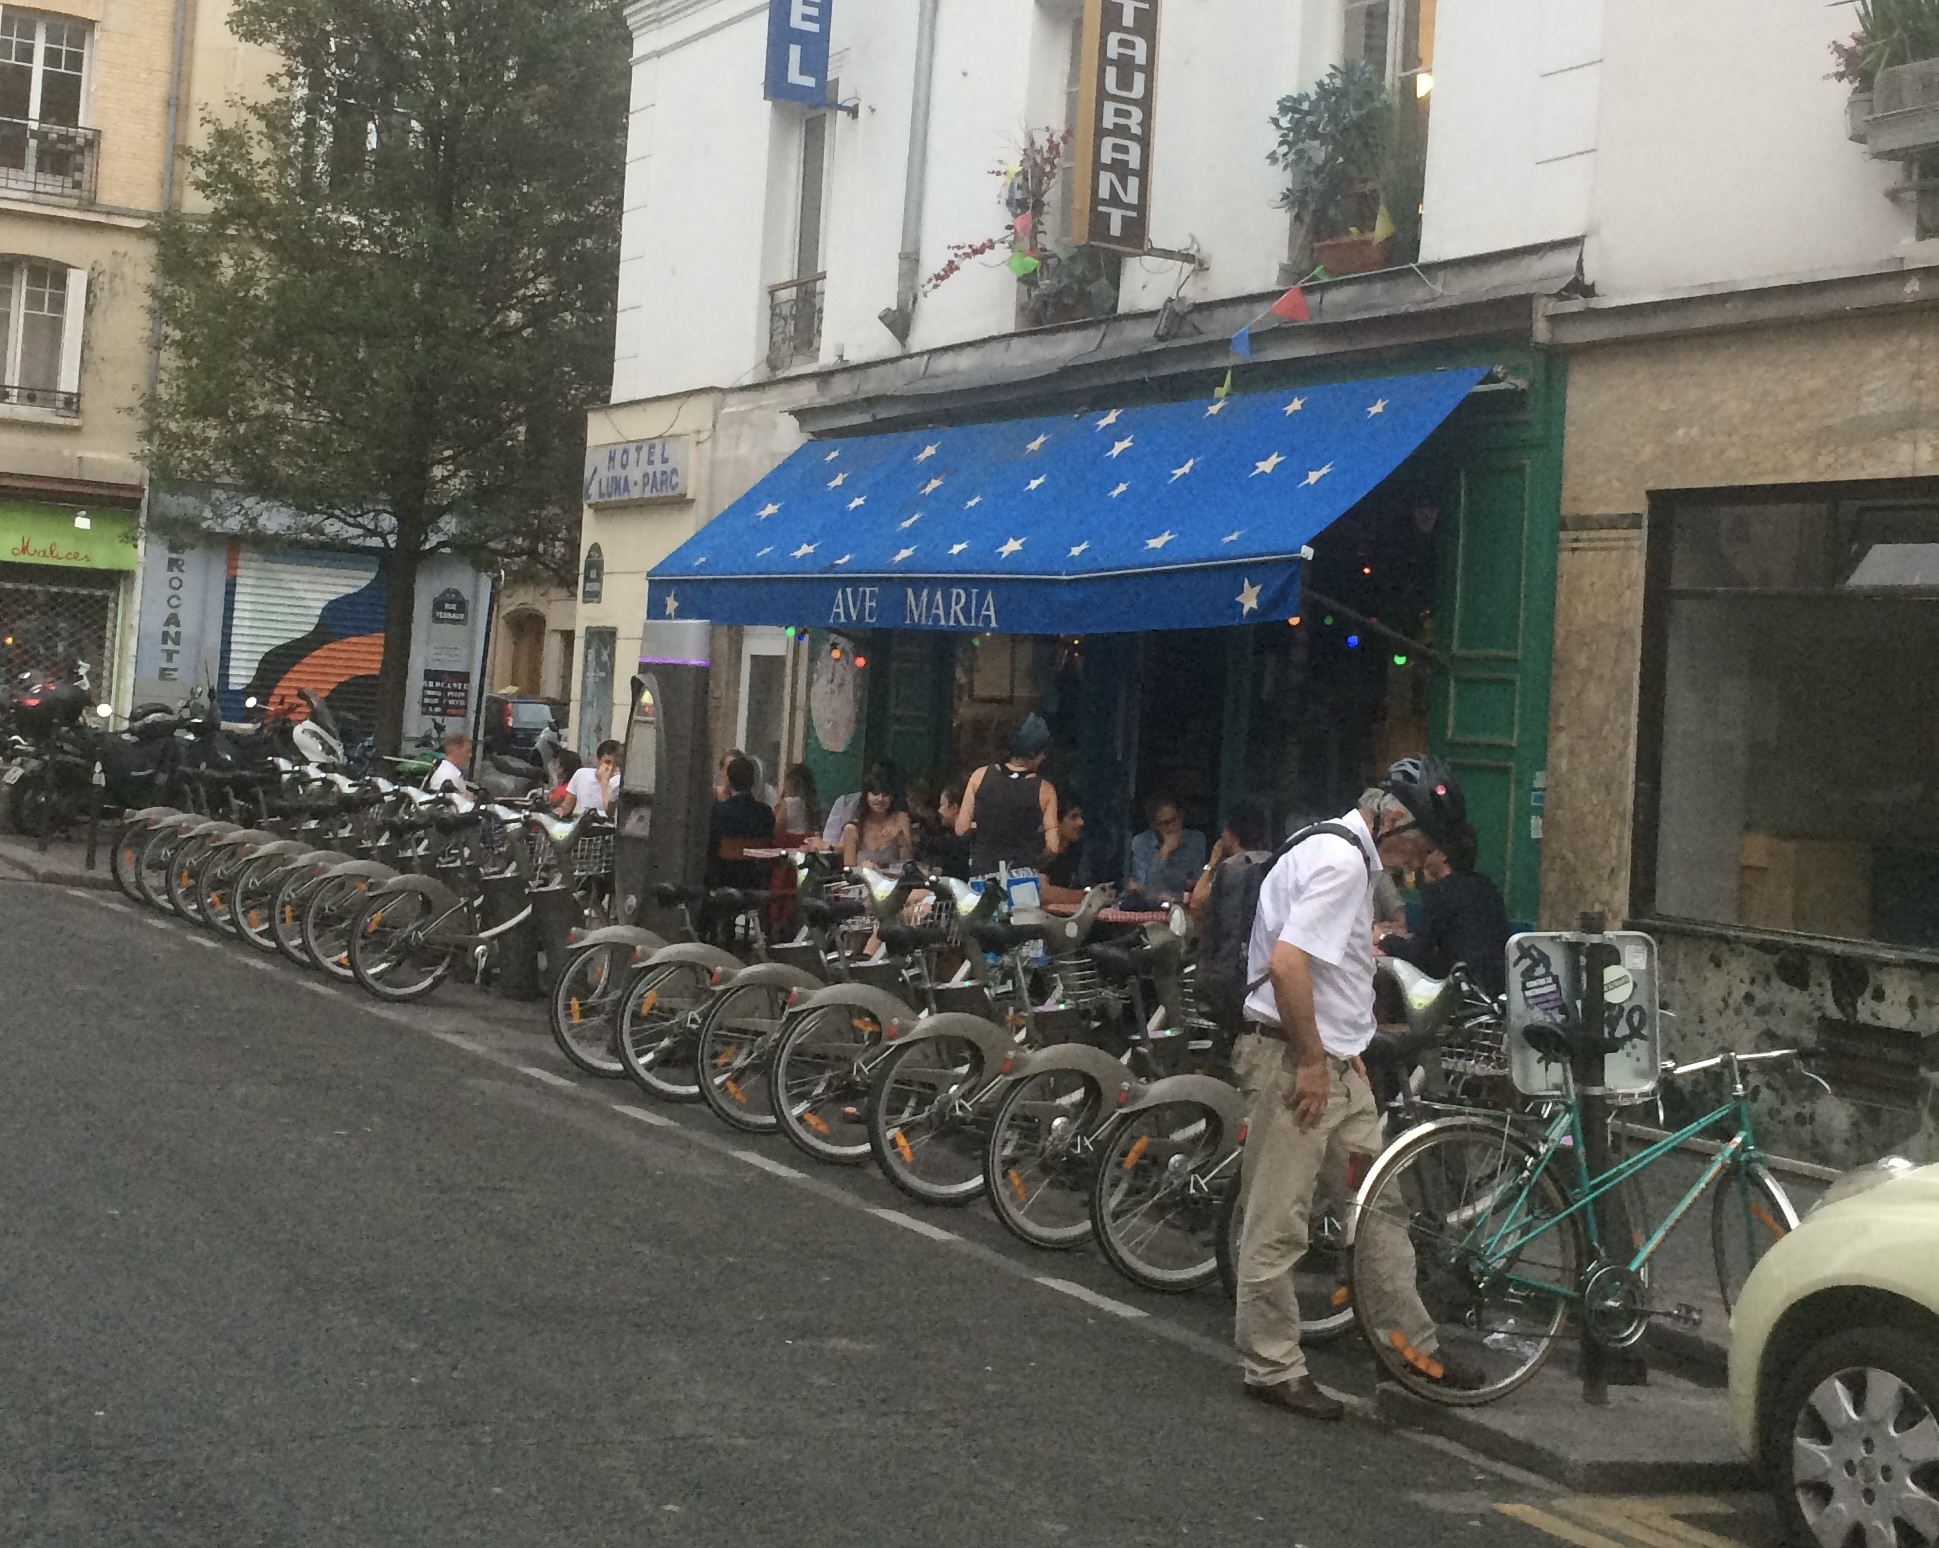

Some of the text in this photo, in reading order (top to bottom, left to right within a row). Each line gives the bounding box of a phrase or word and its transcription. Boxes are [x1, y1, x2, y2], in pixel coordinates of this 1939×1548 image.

[1097, 0, 1149, 237] TAURANT
[608, 443, 669, 472] HOTEL
[11, 536, 91, 562] Malices
[829, 586, 998, 628] AVE MARIA
